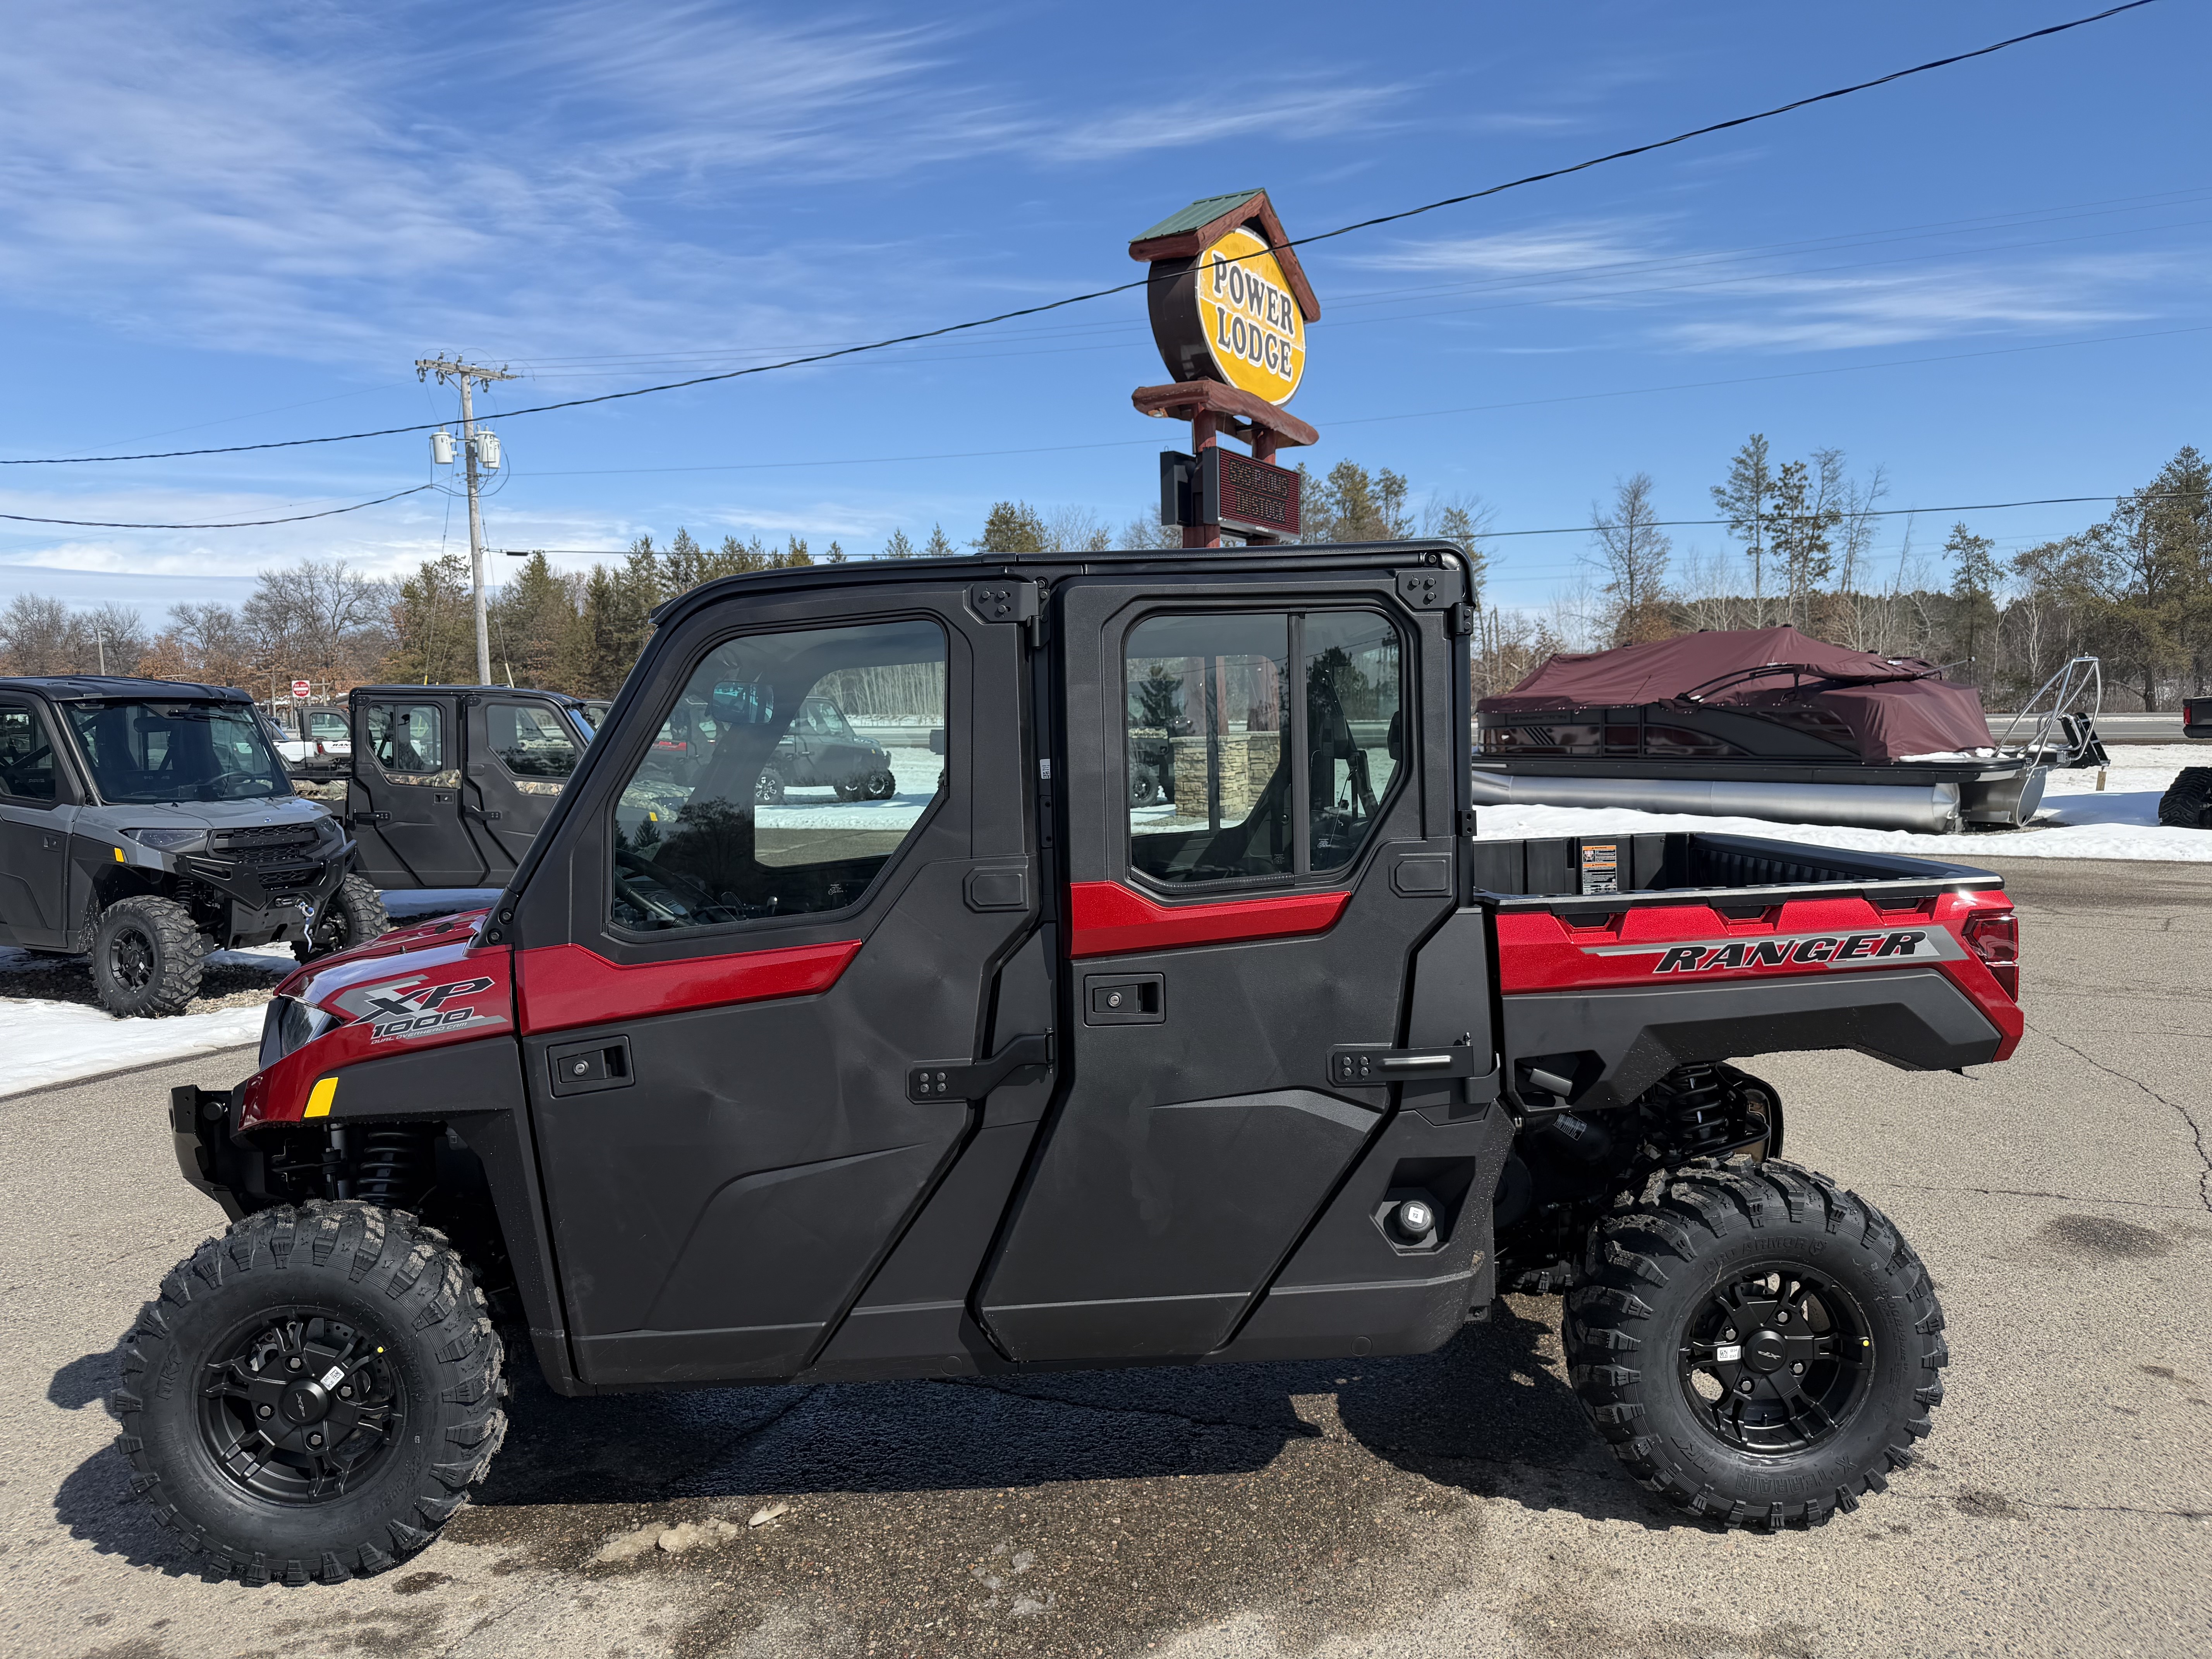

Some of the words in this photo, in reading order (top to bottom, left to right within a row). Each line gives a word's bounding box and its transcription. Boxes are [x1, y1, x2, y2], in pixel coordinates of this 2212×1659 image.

[1212, 253, 1294, 335] POWER
[1217, 306, 1292, 378] LODGE
[1653, 930, 1927, 973] RANGER
[342, 976, 495, 1028] XP
[370, 1006, 474, 1040] 1000
[371, 1037, 394, 1045] DUAL
[396, 1026, 445, 1039] OVERHEAD
[447, 1022, 467, 1030] CAM
[1739, 1237, 1809, 1254] ARMOR
[1757, 1350, 1782, 1360] XP
[296, 1393, 306, 1417] XP
[1735, 1455, 1858, 1495] X-TERRAIN
